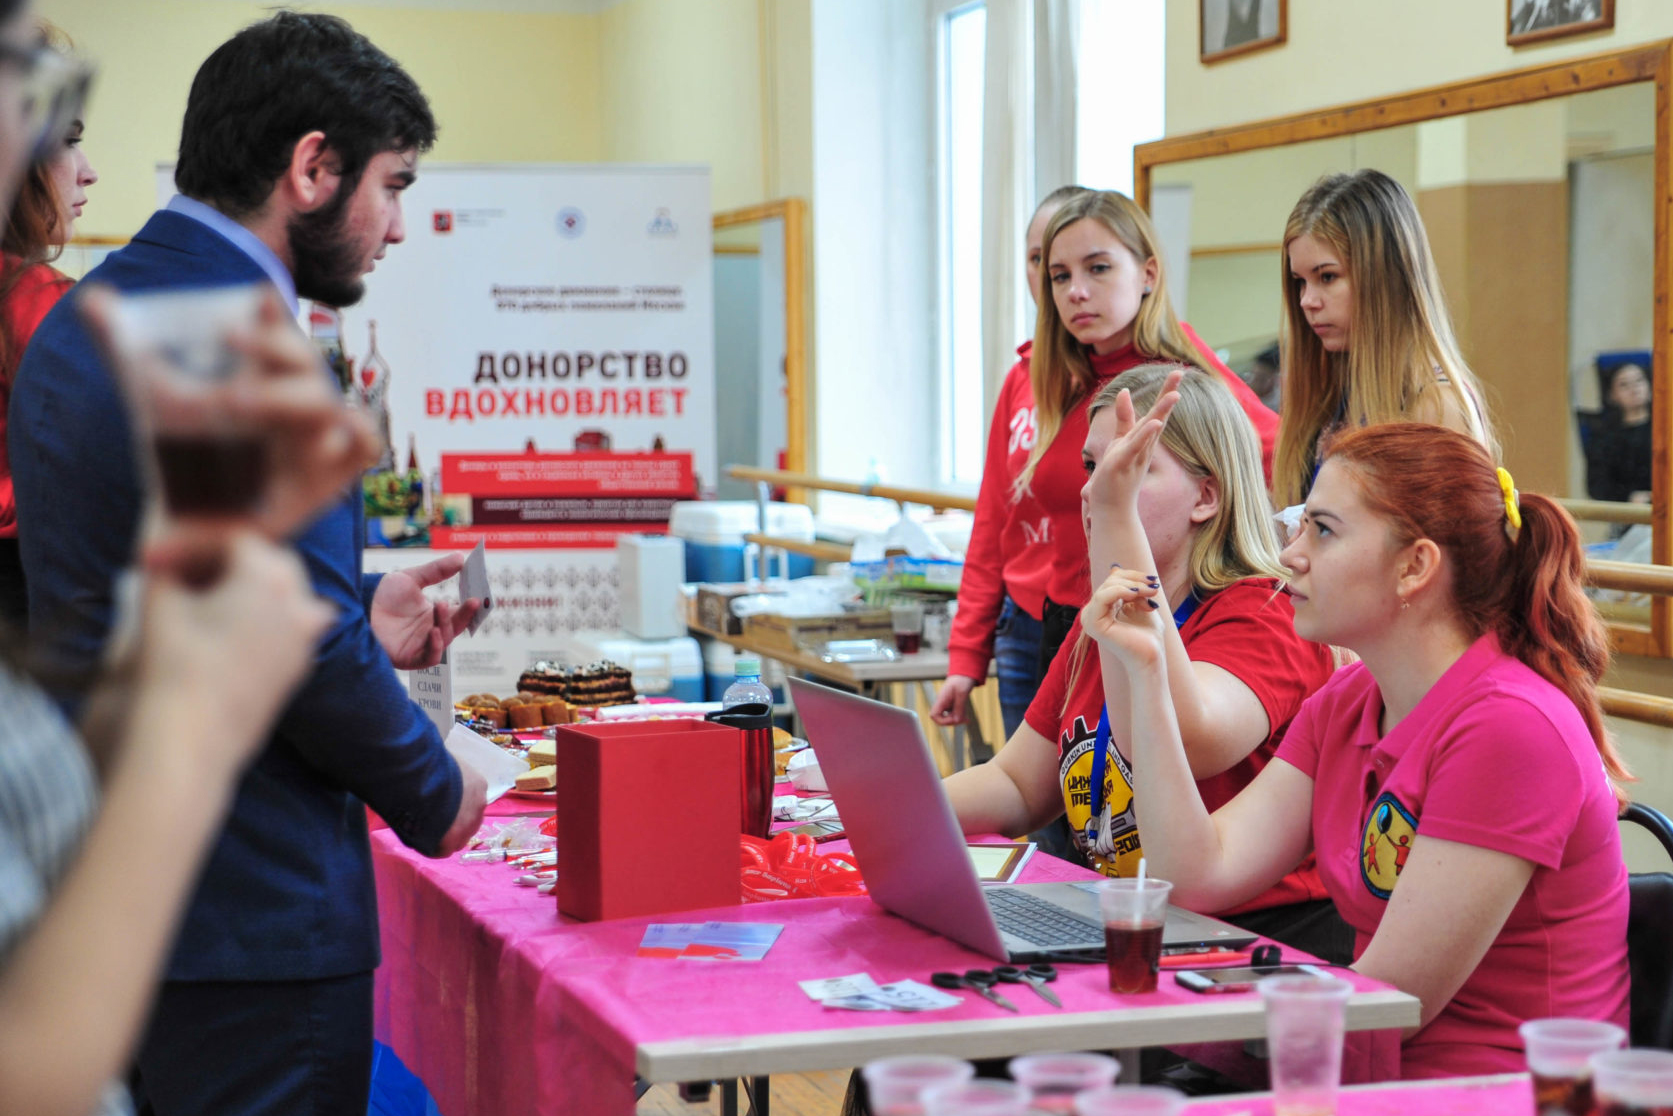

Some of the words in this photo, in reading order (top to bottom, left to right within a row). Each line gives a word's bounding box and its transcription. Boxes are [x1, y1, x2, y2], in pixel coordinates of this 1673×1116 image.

[474, 352, 688, 384] ДОНОРСТВО
[425, 388, 688, 421] ВДОХНОВЛЯЕТ
[417, 681, 442, 694] СДАЧИ
[418, 697, 442, 711] КРОВИ
